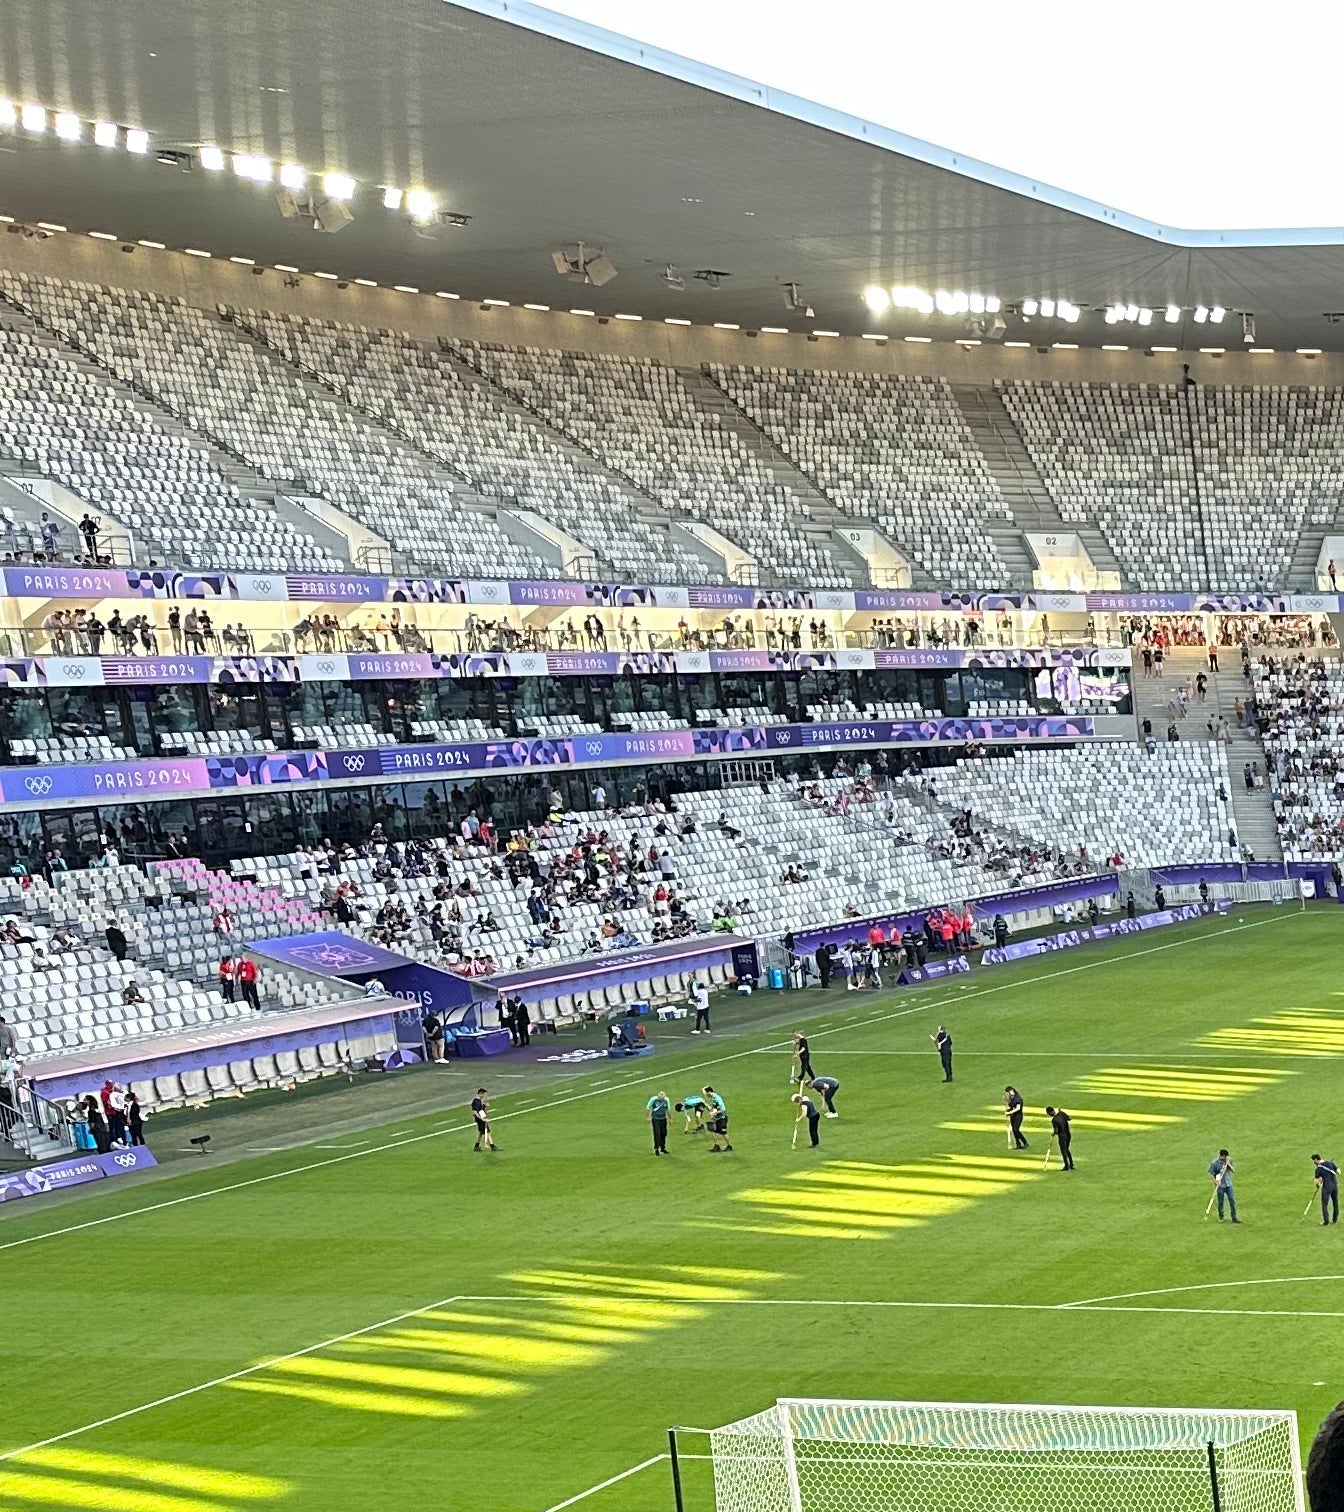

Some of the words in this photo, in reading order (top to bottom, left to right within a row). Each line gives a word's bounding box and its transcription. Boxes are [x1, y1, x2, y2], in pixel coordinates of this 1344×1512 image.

[25, 575, 69, 591] PARIS
[72, 573, 113, 590] 2024
[520, 587, 551, 600] PARIS
[551, 588, 577, 601] 2024
[866, 595, 897, 606] PARIS
[900, 596, 930, 607] 2024
[1101, 598, 1138, 609] PARIS
[1140, 598, 1175, 609] 2024
[360, 660, 392, 673] PARIS
[394, 660, 422, 672] 2024
[885, 654, 919, 664] PARIS
[920, 654, 949, 664] 2024
[118, 664, 157, 678] PARIS
[160, 663, 196, 677] 2024
[811, 728, 841, 741] PARIS
[844, 726, 876, 740] 2024
[625, 739, 656, 753] PARIS
[657, 738, 685, 751] 2024
[395, 752, 434, 768] PARIS
[436, 751, 471, 765] 2024
[94, 771, 144, 790] PARIS
[148, 767, 192, 787] 2024
